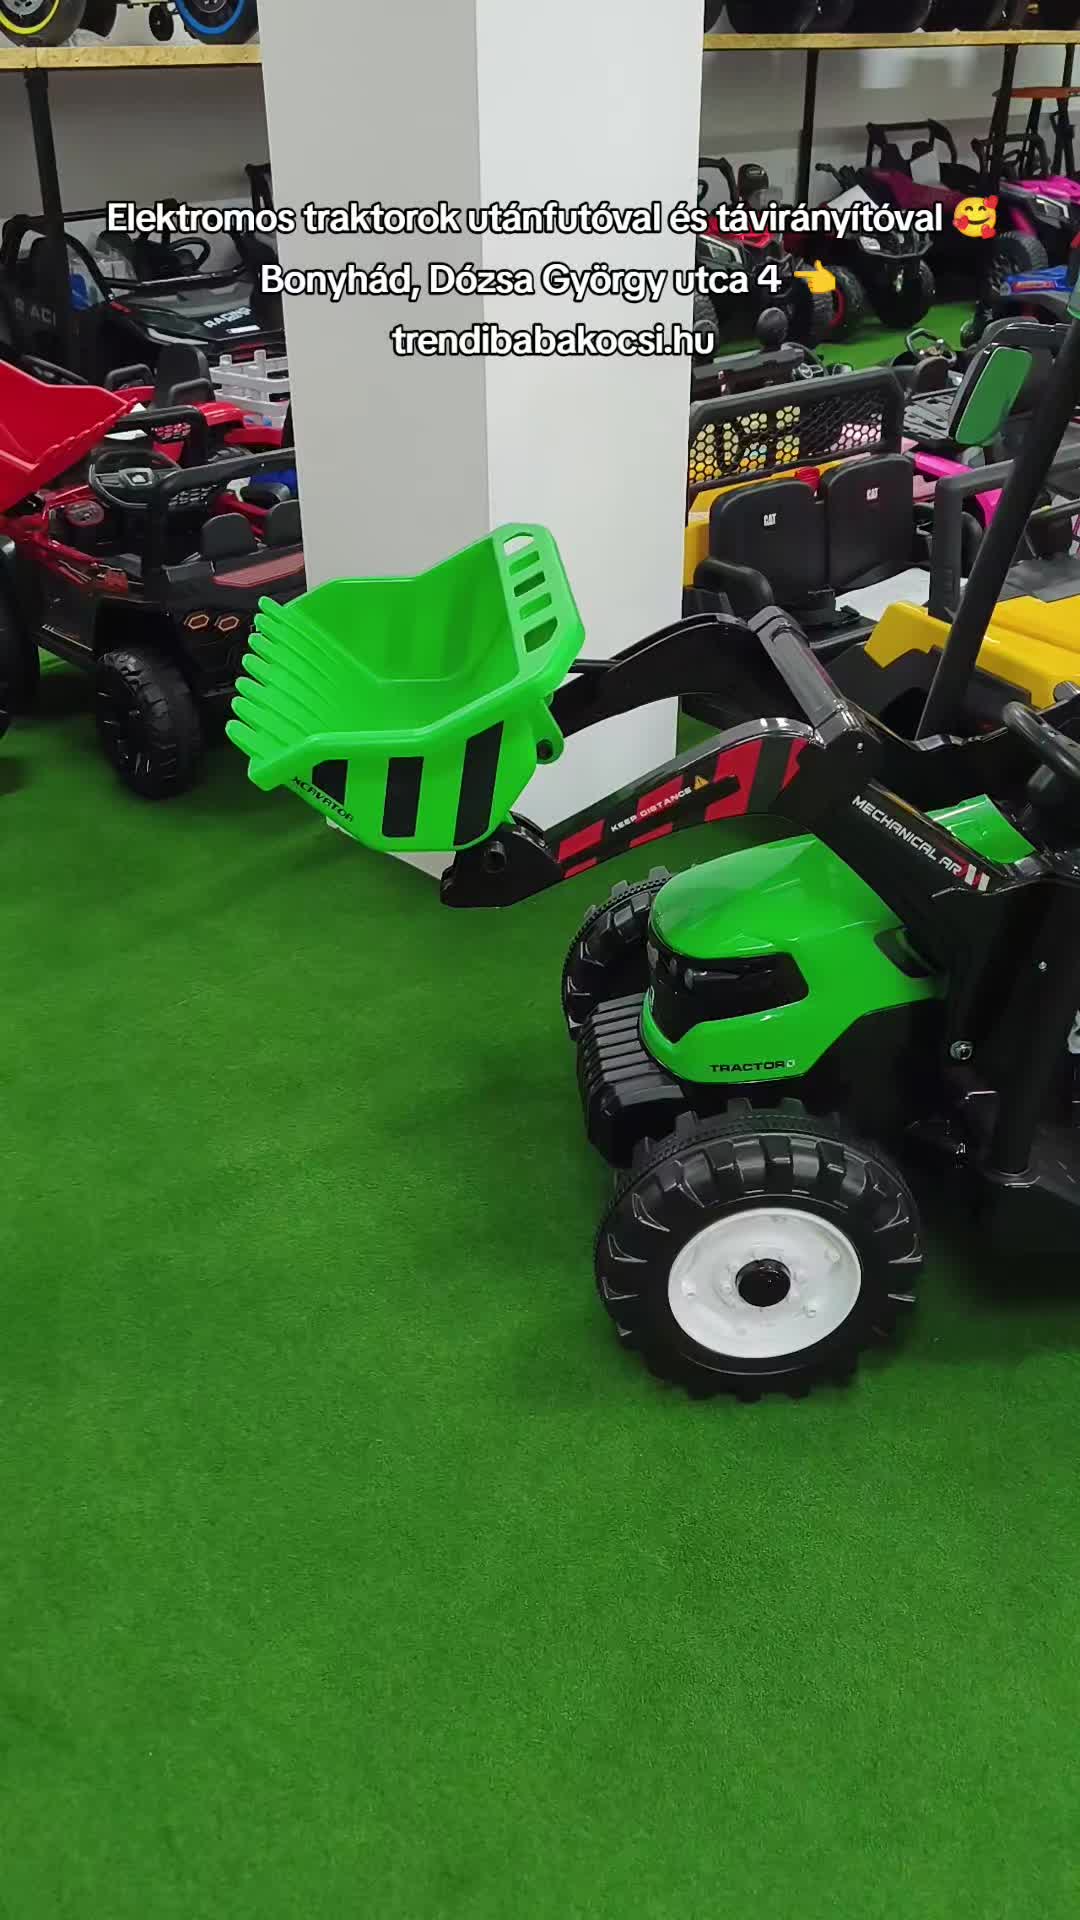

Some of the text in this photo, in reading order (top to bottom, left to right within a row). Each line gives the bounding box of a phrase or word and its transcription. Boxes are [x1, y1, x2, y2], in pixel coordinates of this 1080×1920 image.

[866, 487, 880, 501] CAT
[763, 513, 777, 527] CAT
[610, 786, 693, 833] KEEP DISTANCE
[851, 795, 937, 861] MECHANICAL
[710, 1060, 786, 1073] TRACTOR
